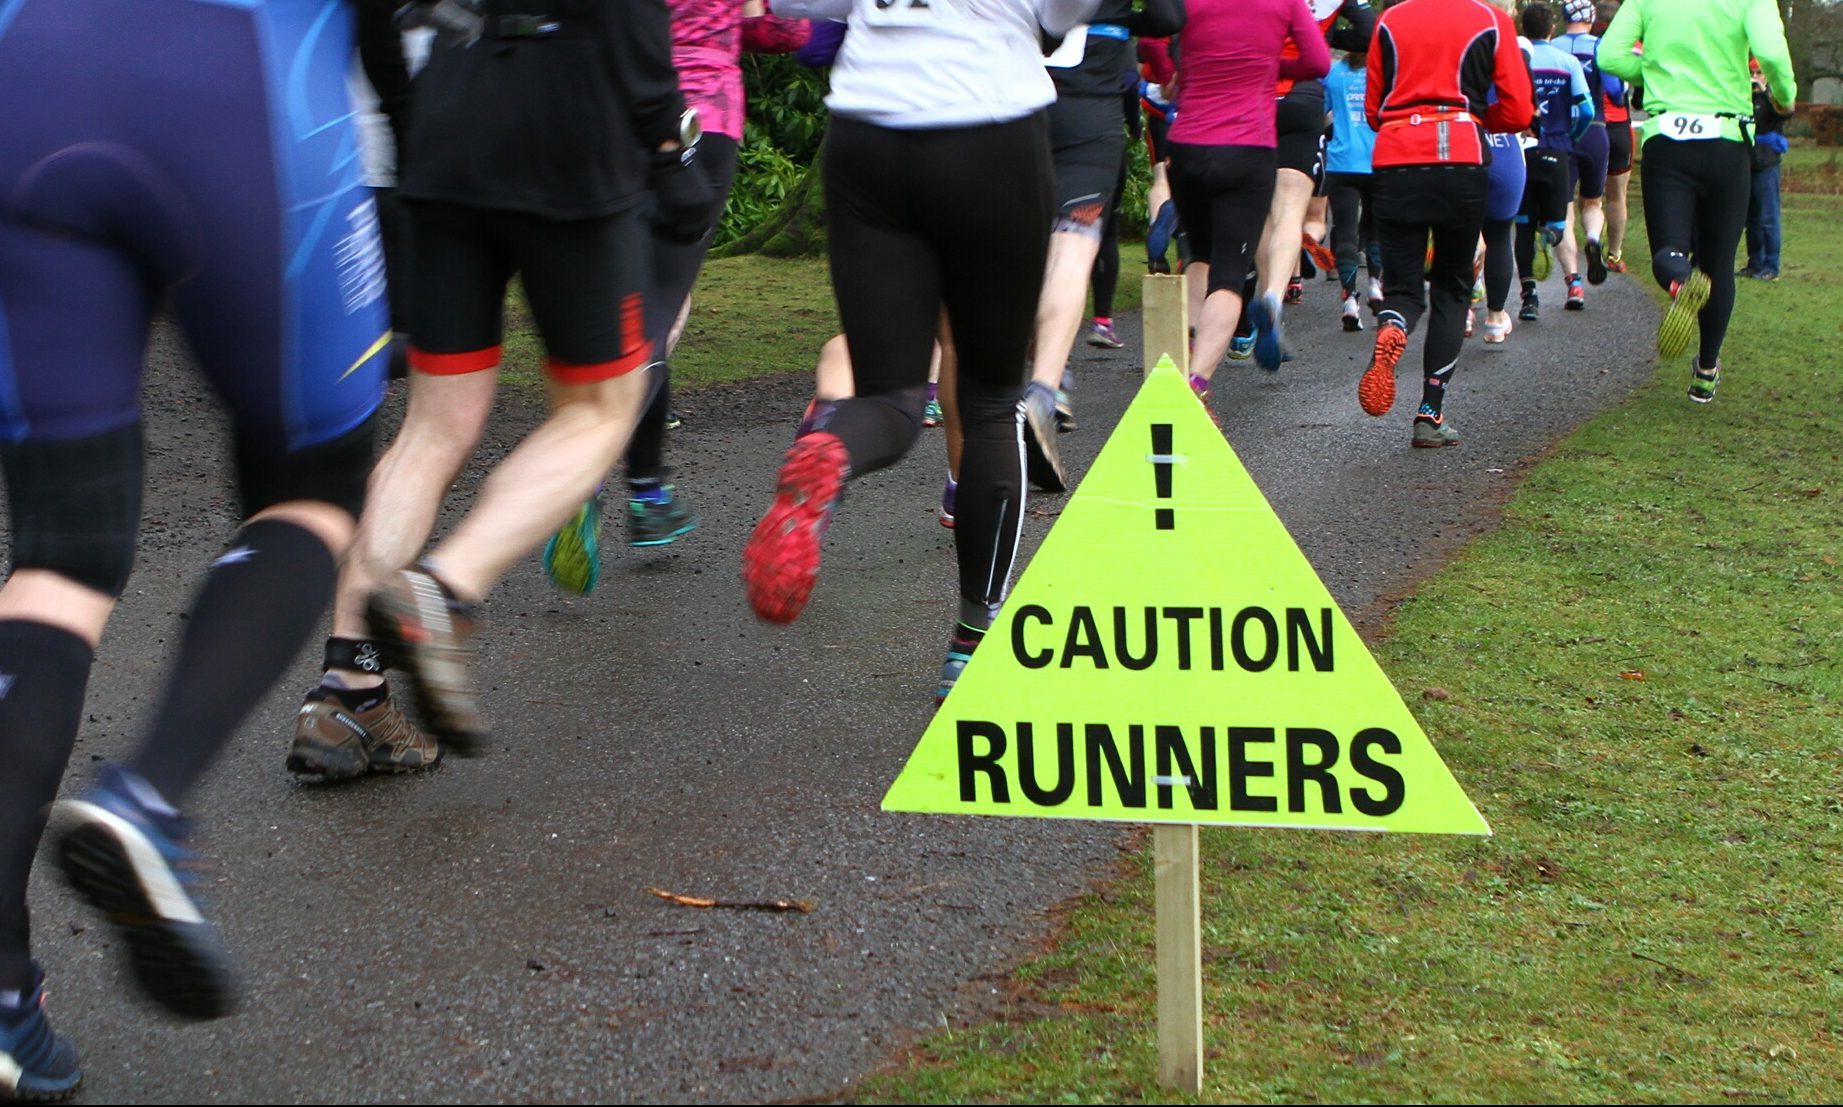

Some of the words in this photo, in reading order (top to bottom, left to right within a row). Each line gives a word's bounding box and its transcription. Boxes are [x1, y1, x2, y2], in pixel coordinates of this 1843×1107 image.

[1674, 116, 1703, 135] 96
[1150, 423, 1175, 531] !
[1011, 604, 1335, 673] CAUTION
[956, 719, 1406, 817] RUNNERS
